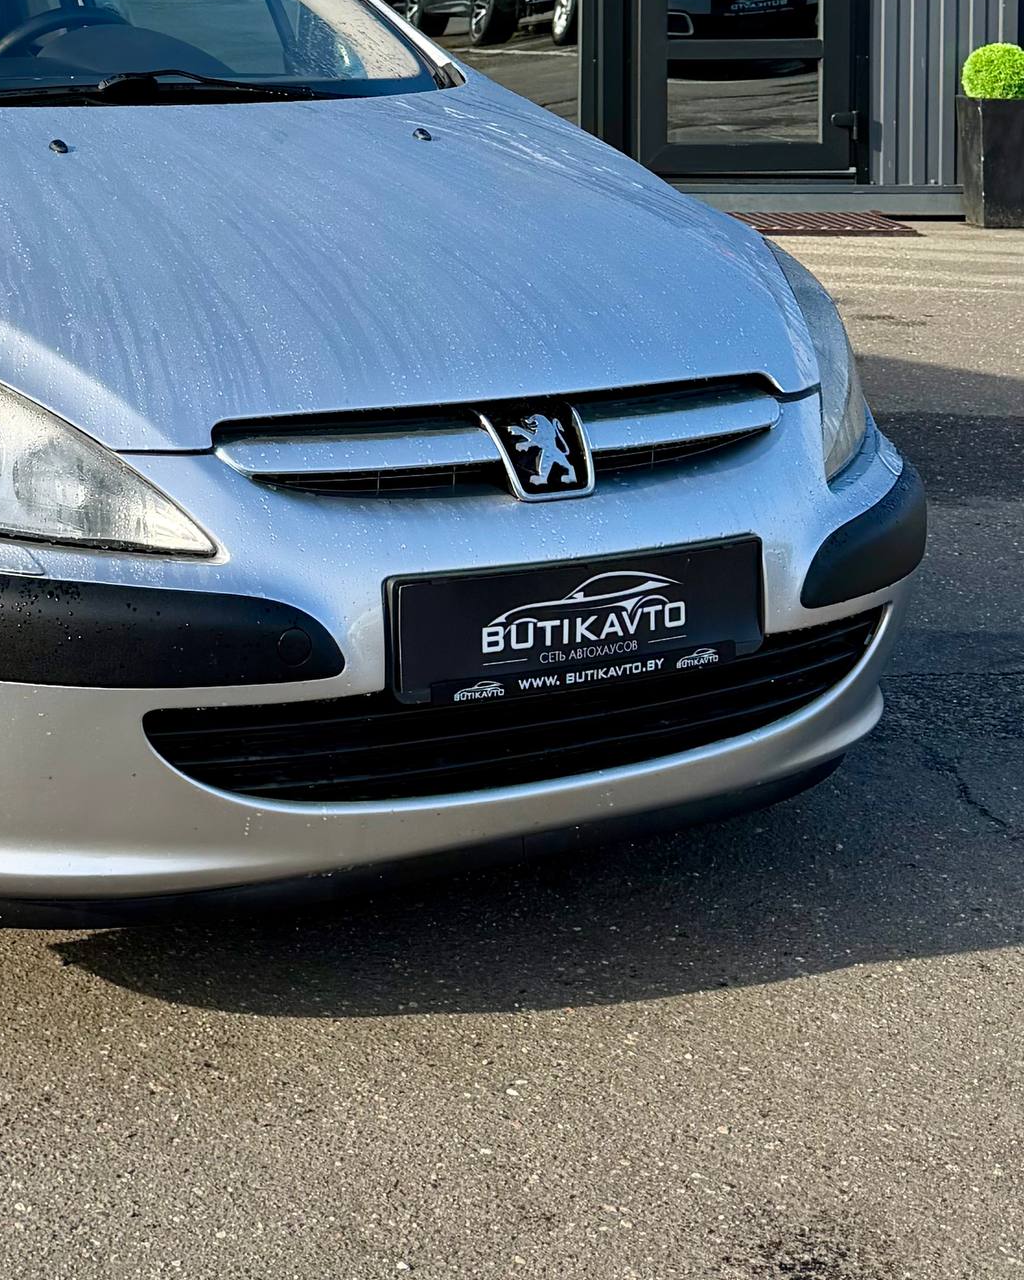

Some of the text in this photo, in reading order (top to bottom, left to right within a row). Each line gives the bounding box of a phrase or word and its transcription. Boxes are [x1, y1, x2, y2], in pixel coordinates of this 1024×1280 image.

[481, 601, 686, 654] BUTIKAVTO
[539, 640, 638, 664] СЕТЬ АВТОХАУСОВ
[677, 654, 719, 669] BUTIKAVTO
[453, 688, 505, 702] BUTIKAVTO
